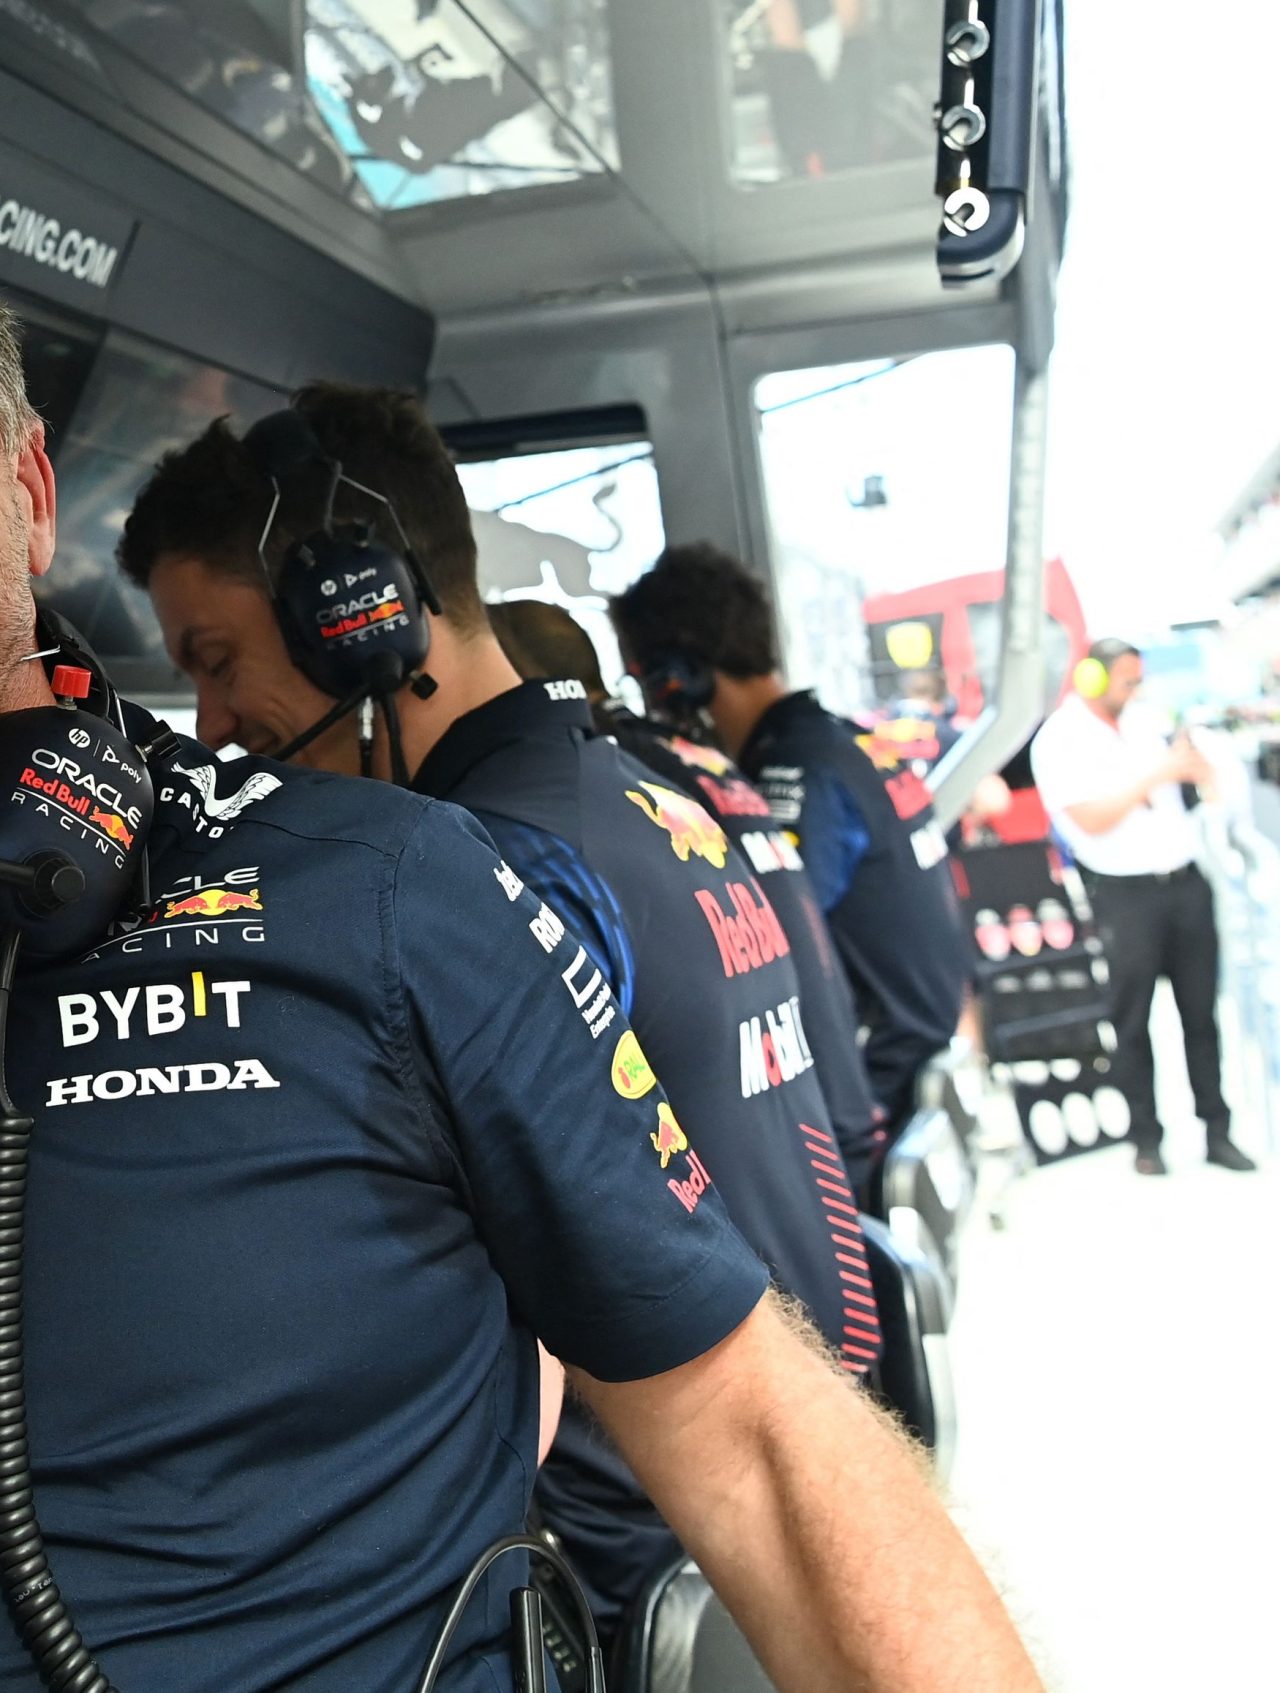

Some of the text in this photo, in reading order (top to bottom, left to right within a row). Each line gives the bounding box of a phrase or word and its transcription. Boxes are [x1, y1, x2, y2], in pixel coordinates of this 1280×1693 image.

[316, 583, 400, 624] ORACLE
[68, 728, 91, 748] hp
[19, 768, 91, 815] Red Bull
[32, 748, 142, 829] ORACLE
[120, 762, 142, 783] poly
[11, 792, 125, 869] RACING
[160, 787, 234, 838] CASTO
[81, 926, 265, 964] ACING
[57, 971, 252, 1048] BYBIT
[45, 1059, 281, 1107] HONDA
